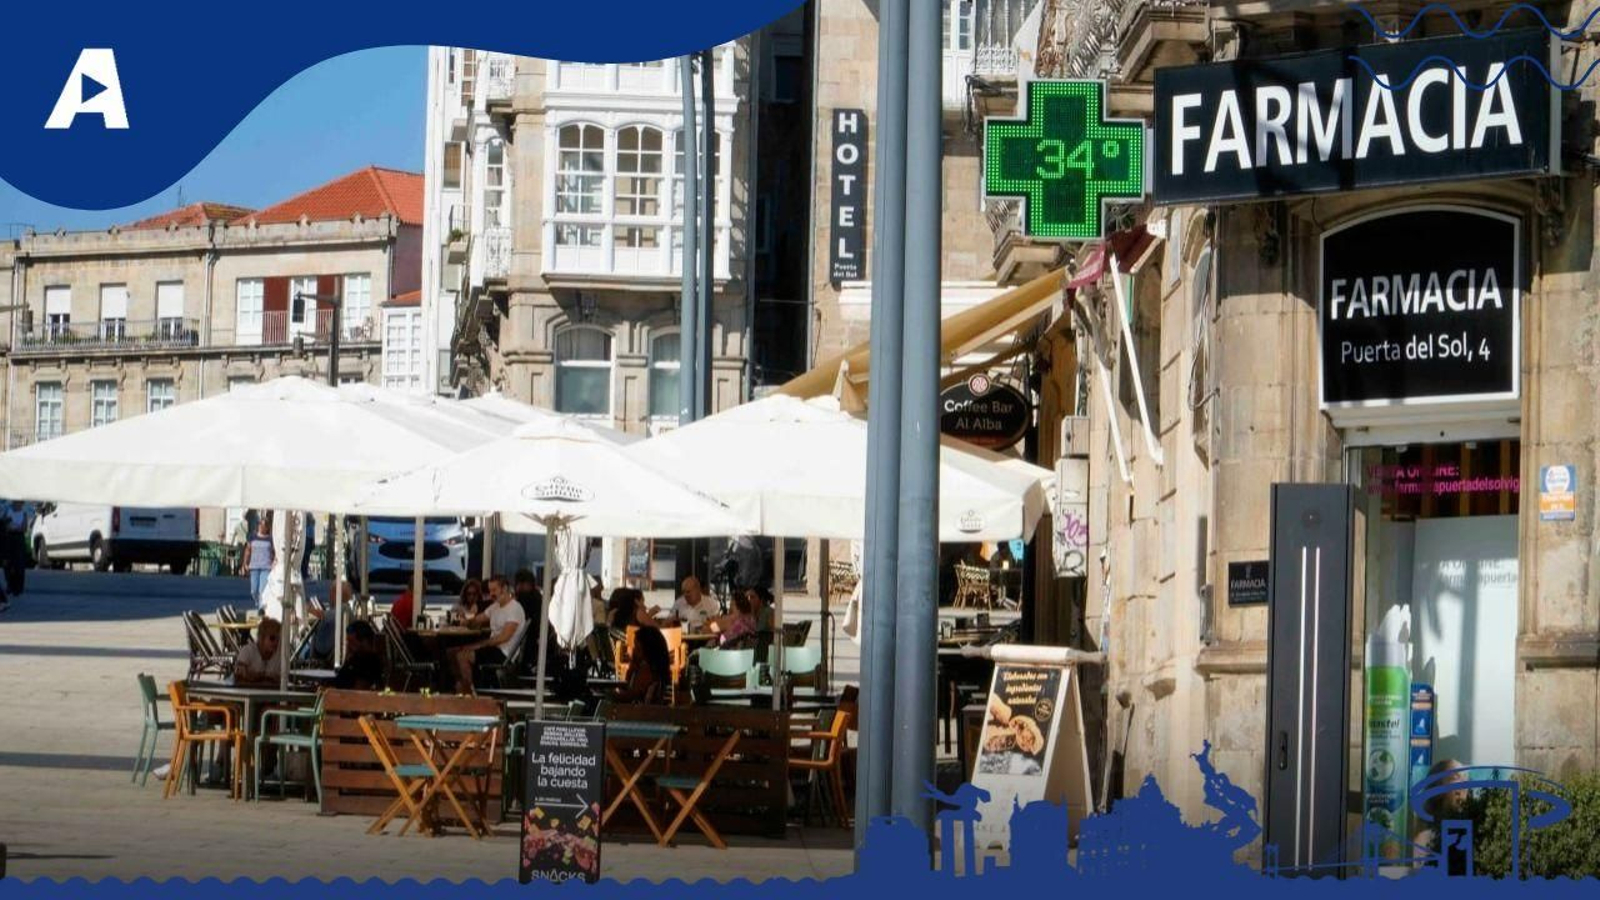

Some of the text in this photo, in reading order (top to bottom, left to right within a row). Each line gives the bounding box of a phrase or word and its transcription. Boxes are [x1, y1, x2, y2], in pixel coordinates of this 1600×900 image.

[1171, 61, 1523, 176] FARMACIA
[1037, 139, 1119, 179] 34°
[836, 112, 859, 259] HOTEL
[1331, 267, 1503, 320] FARMACIA
[1341, 331, 1490, 364] Puerta del Sol, 4
[944, 399, 1014, 413] Coffee Bar
[955, 418, 1003, 430] Al Alba
[531, 752, 596, 766] La felicidad
[537, 775, 588, 789] la cuesta
[540, 764, 586, 778] bajando
